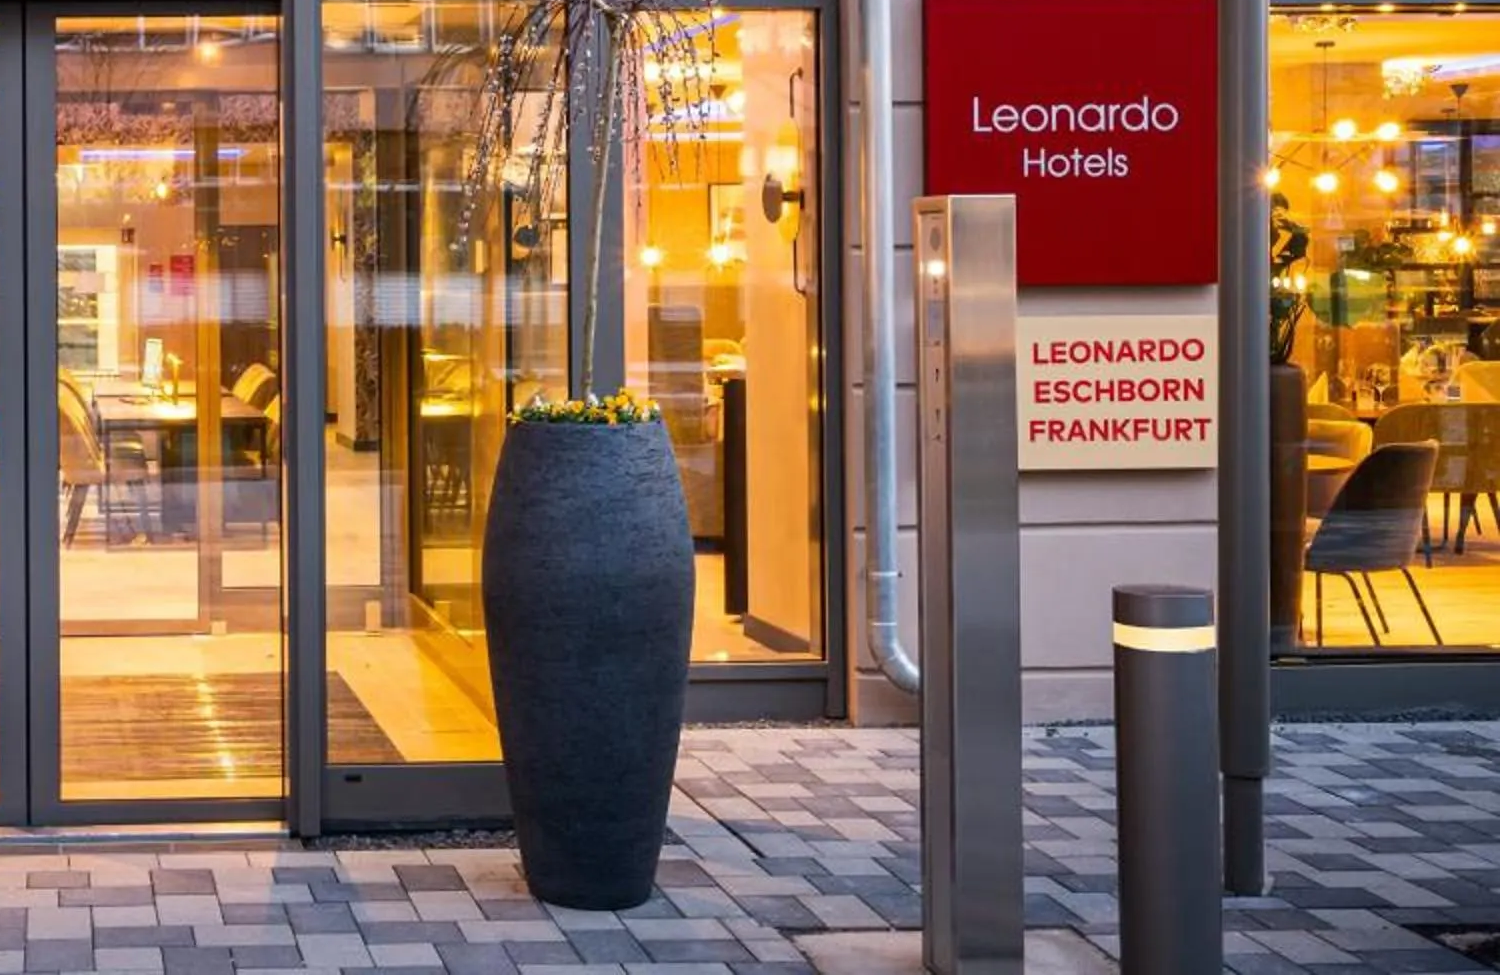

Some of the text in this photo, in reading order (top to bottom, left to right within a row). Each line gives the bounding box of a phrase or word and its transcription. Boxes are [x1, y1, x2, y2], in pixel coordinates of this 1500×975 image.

[972, 95, 1179, 133] Leonardo
[1022, 147, 1129, 178] Hotels
[1032, 338, 1205, 365] LEONARDO
[1033, 378, 1205, 404] ESCHBORN
[1029, 417, 1212, 443] FRANKFURT
